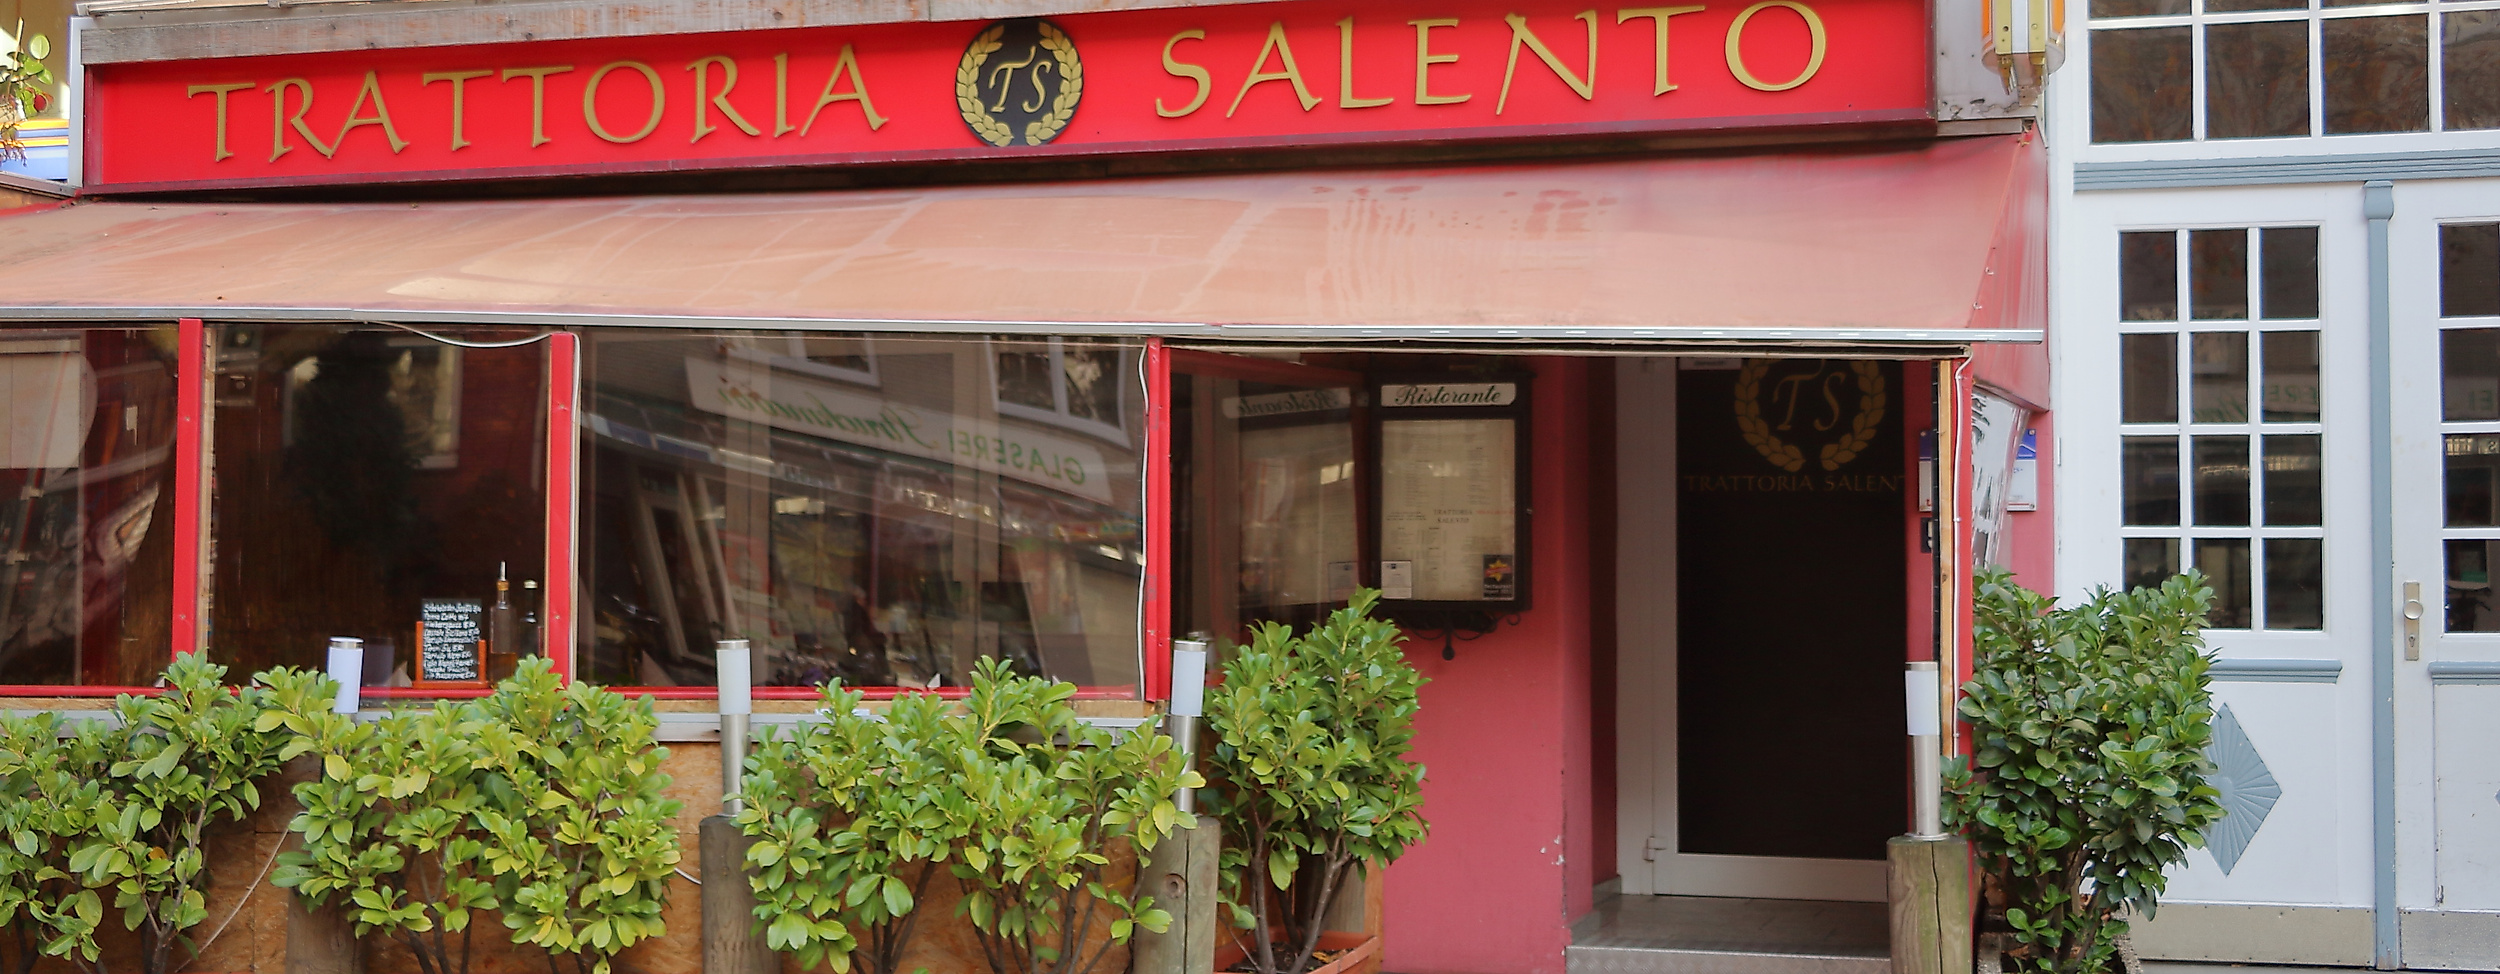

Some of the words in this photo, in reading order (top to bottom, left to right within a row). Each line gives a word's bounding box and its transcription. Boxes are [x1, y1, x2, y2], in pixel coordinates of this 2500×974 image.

[187, 44, 889, 163] TRATTORIA
[1155, 0, 1827, 119] SALENTO
[988, 45, 1052, 113] TS
[1394, 385, 1502, 406] Ristorante
[1684, 474, 1814, 492] TRATTORIA
